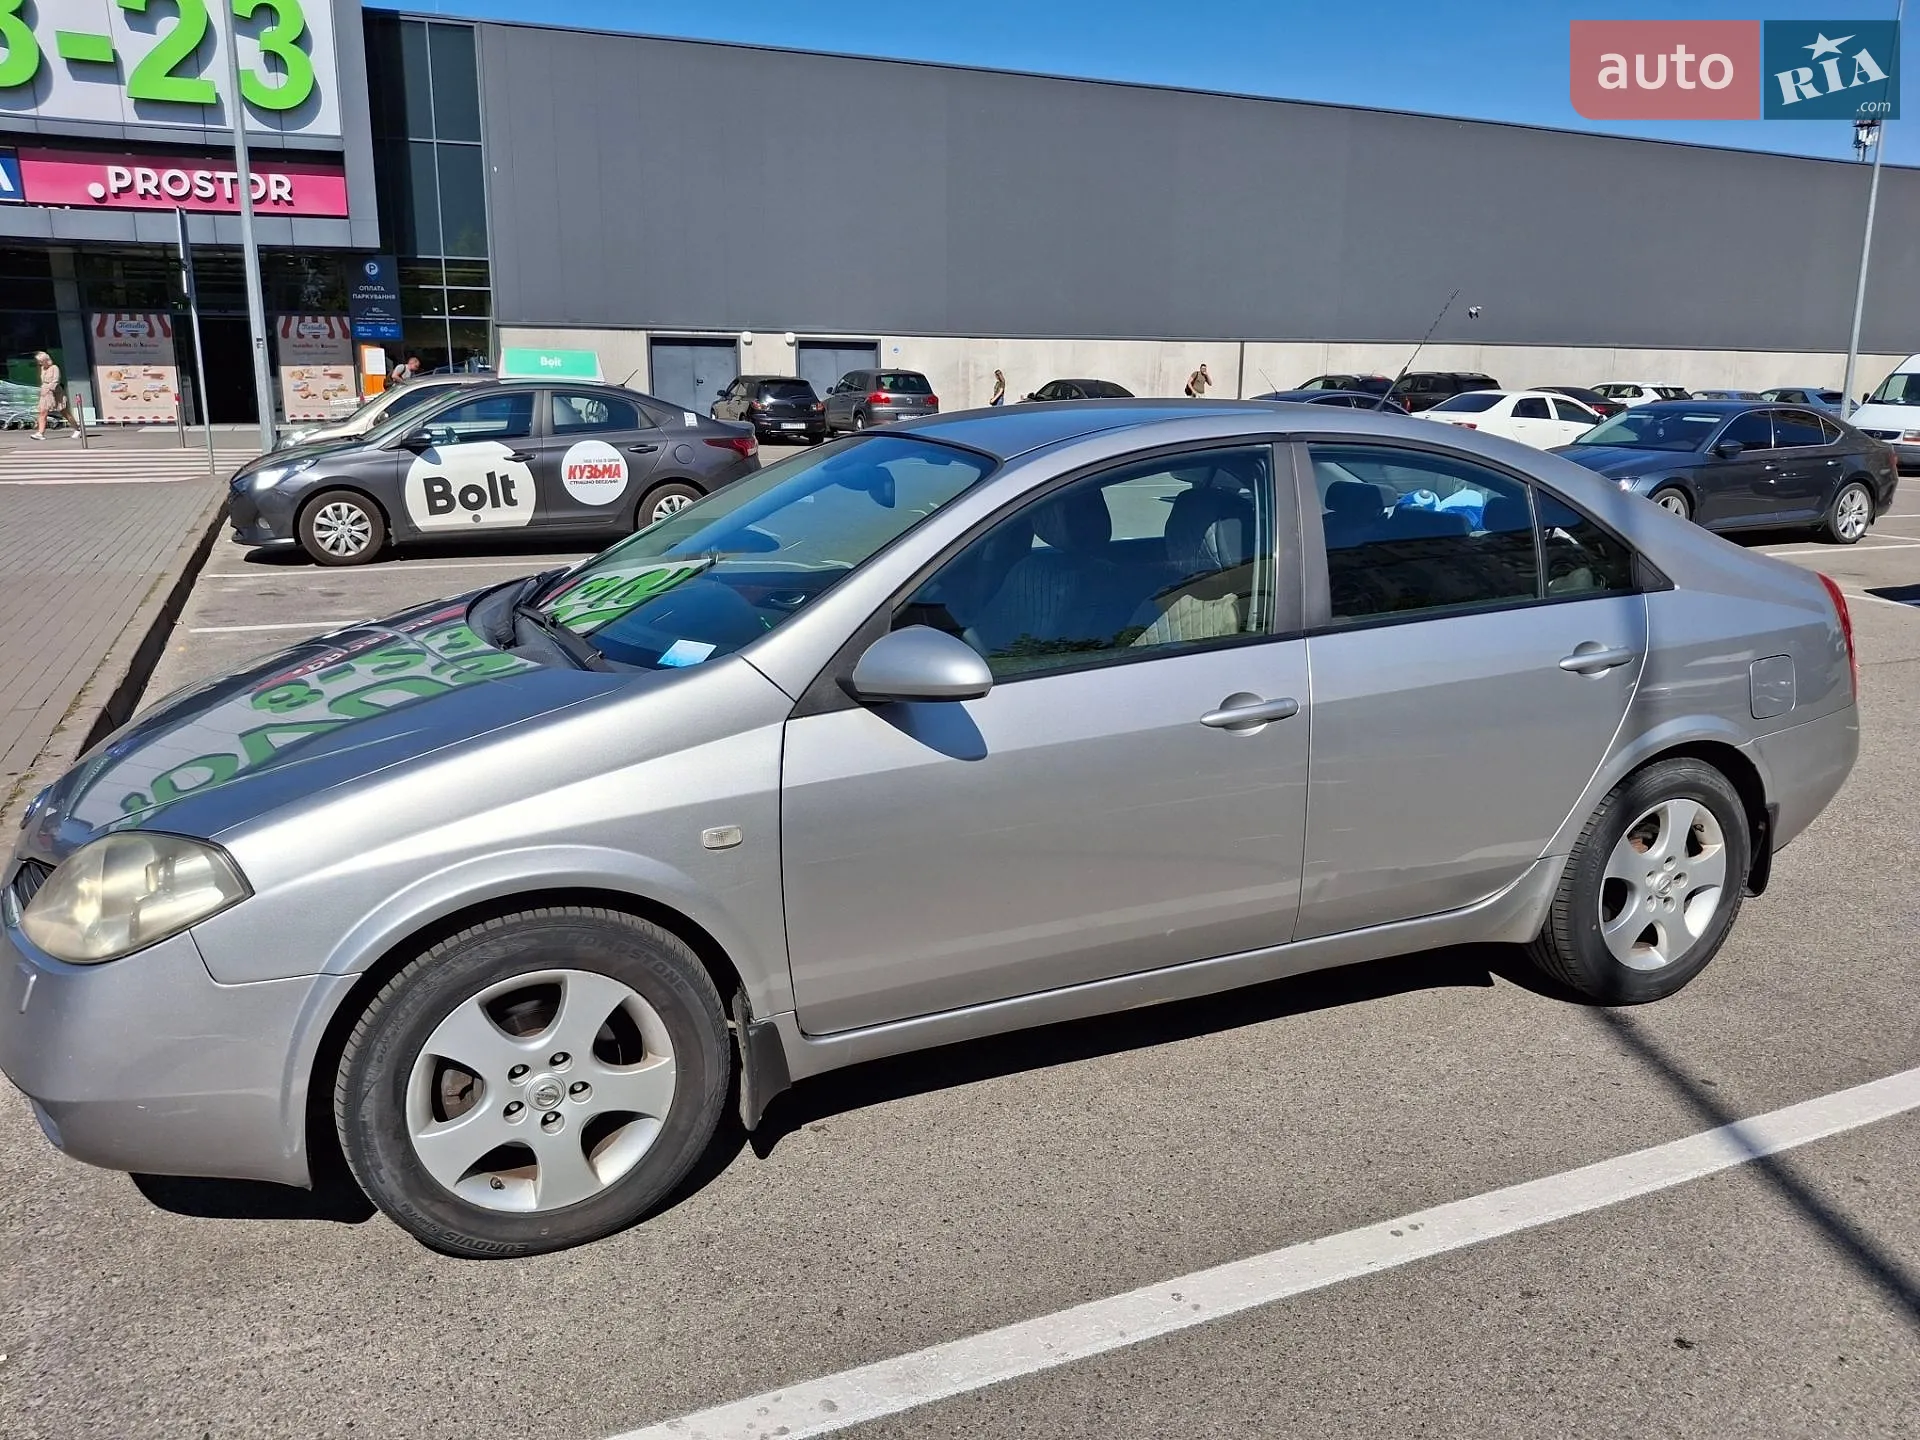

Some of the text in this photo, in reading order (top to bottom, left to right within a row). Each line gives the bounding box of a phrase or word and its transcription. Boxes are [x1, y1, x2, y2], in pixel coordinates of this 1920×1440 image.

[540, 356, 562, 367] Bolt
[567, 464, 622, 480] КУЗЬМА
[423, 472, 518, 519] Bolt
[442, 1231, 530, 1254] EUROVIS
